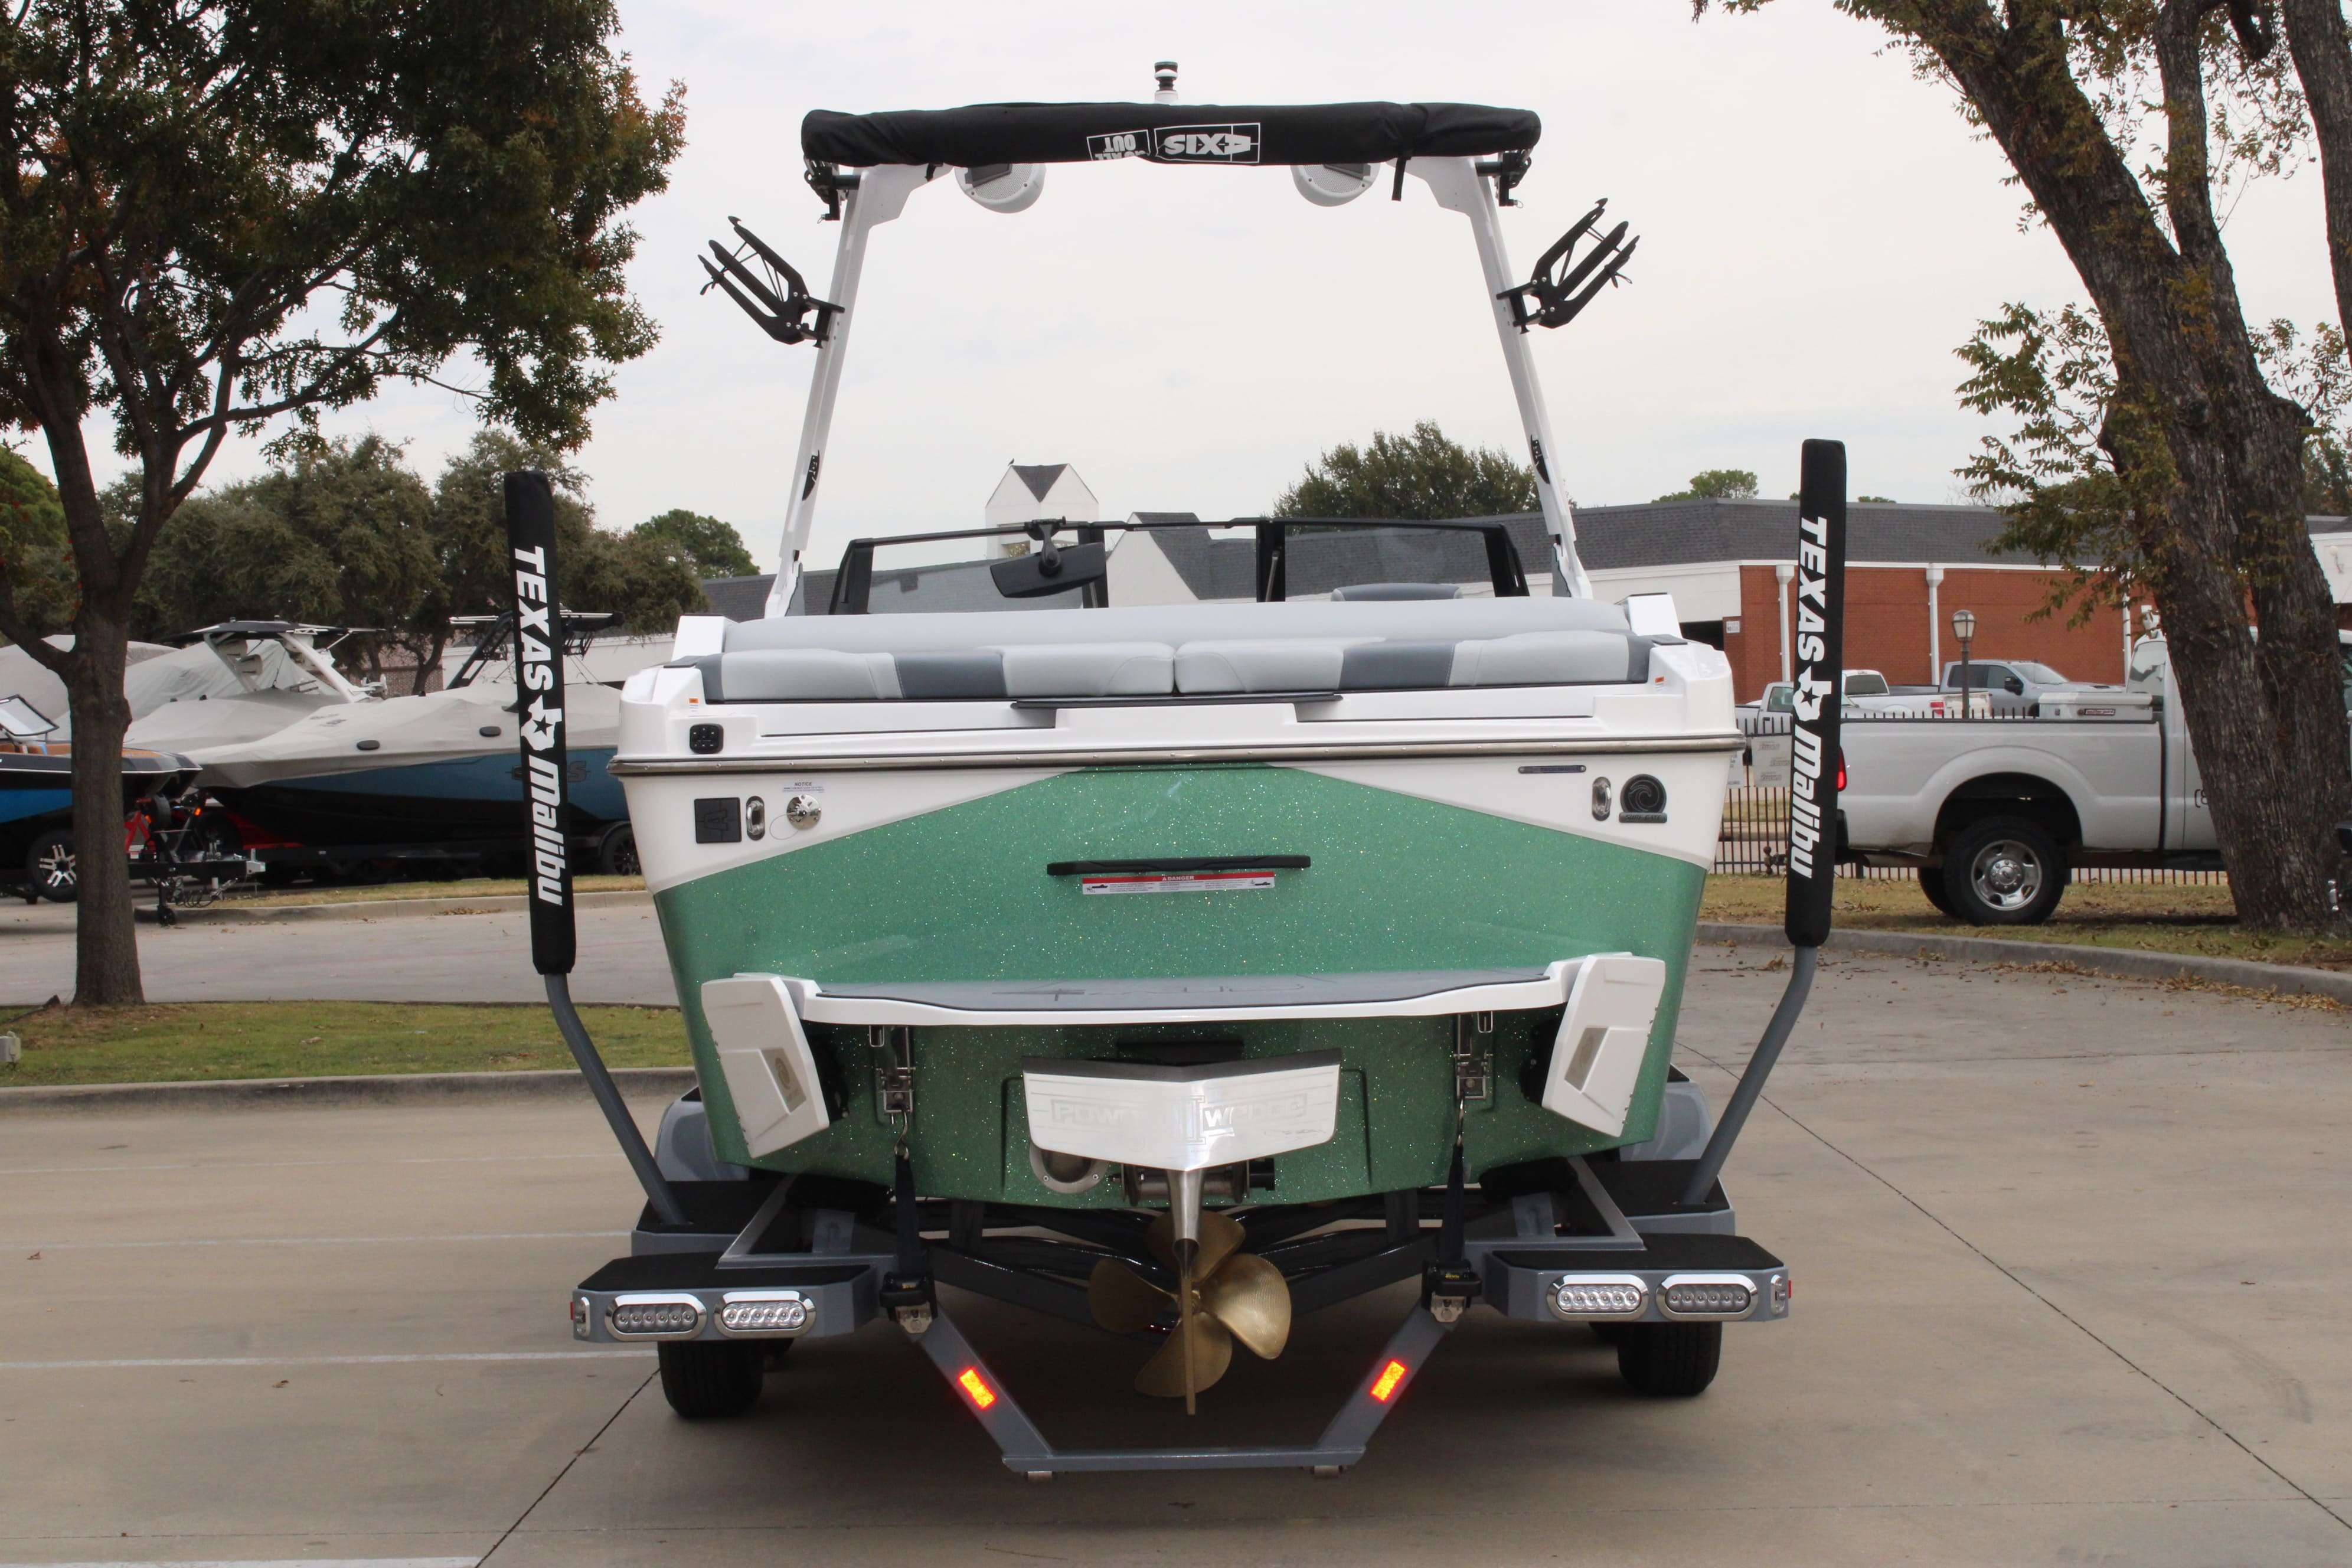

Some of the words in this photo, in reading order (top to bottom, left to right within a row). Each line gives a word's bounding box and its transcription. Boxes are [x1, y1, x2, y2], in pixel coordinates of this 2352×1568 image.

[1104, 134, 1136, 153] OUT
[1165, 133, 1251, 155] AXIS
[515, 545, 553, 690] TEXAS
[1798, 517, 1827, 662] TEXAS
[528, 754, 566, 906] malibu
[1791, 724, 1821, 878] malibu
